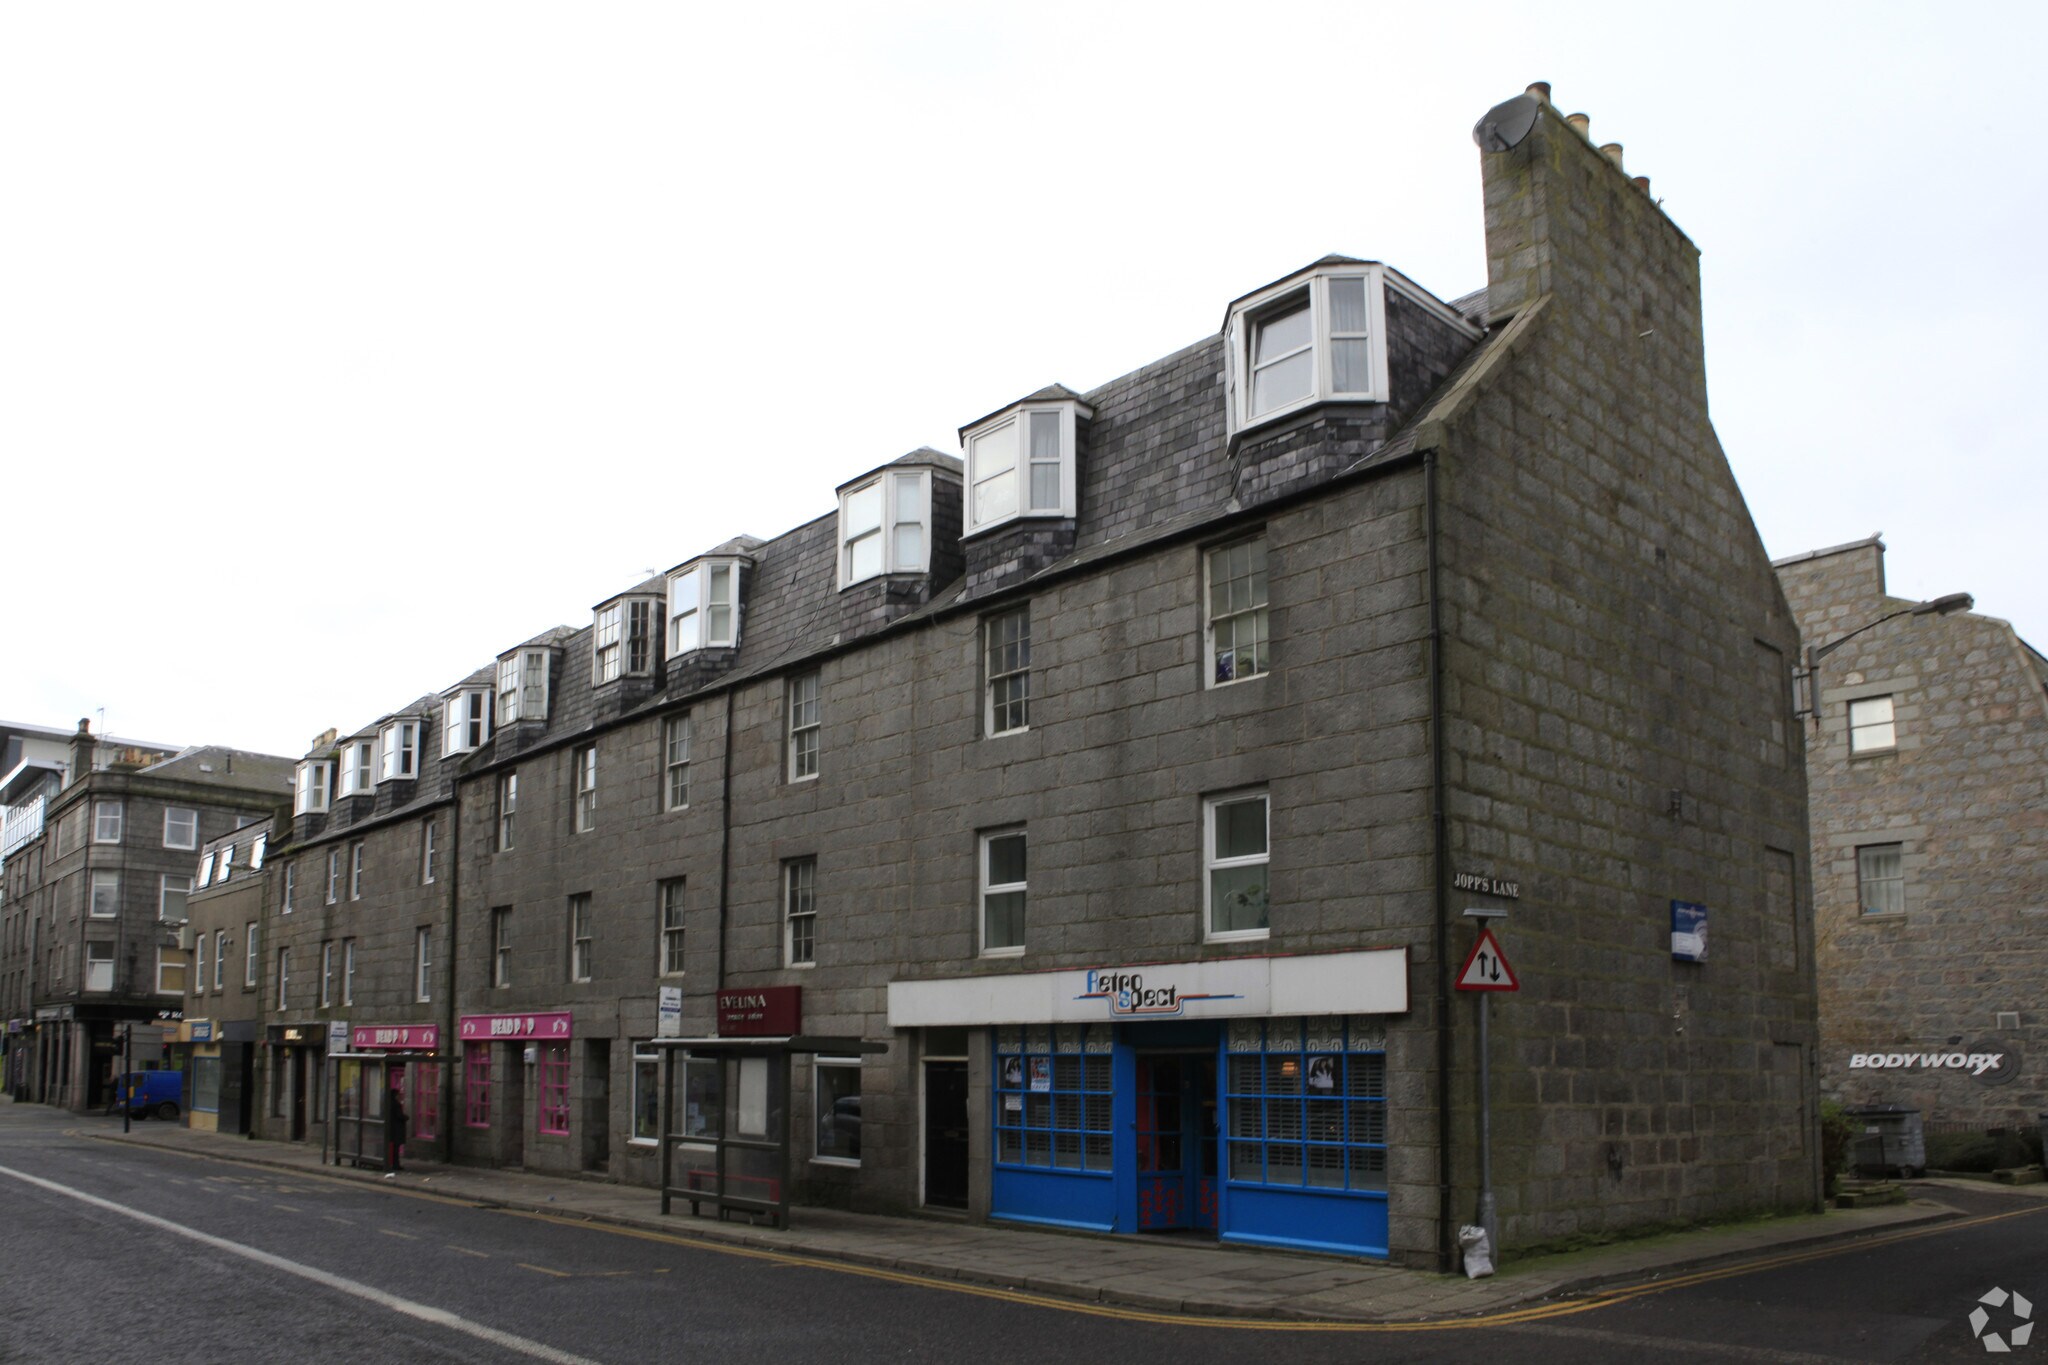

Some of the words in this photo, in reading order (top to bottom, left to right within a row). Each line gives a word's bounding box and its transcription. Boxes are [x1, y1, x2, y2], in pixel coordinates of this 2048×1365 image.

[1454, 873, 1489, 892] JOPP'S
[1492, 880, 1519, 898] LANE
[1087, 969, 1142, 993] Retro
[720, 994, 767, 1009] EVELINA
[1849, 1053, 2004, 1076] BODYWORX
